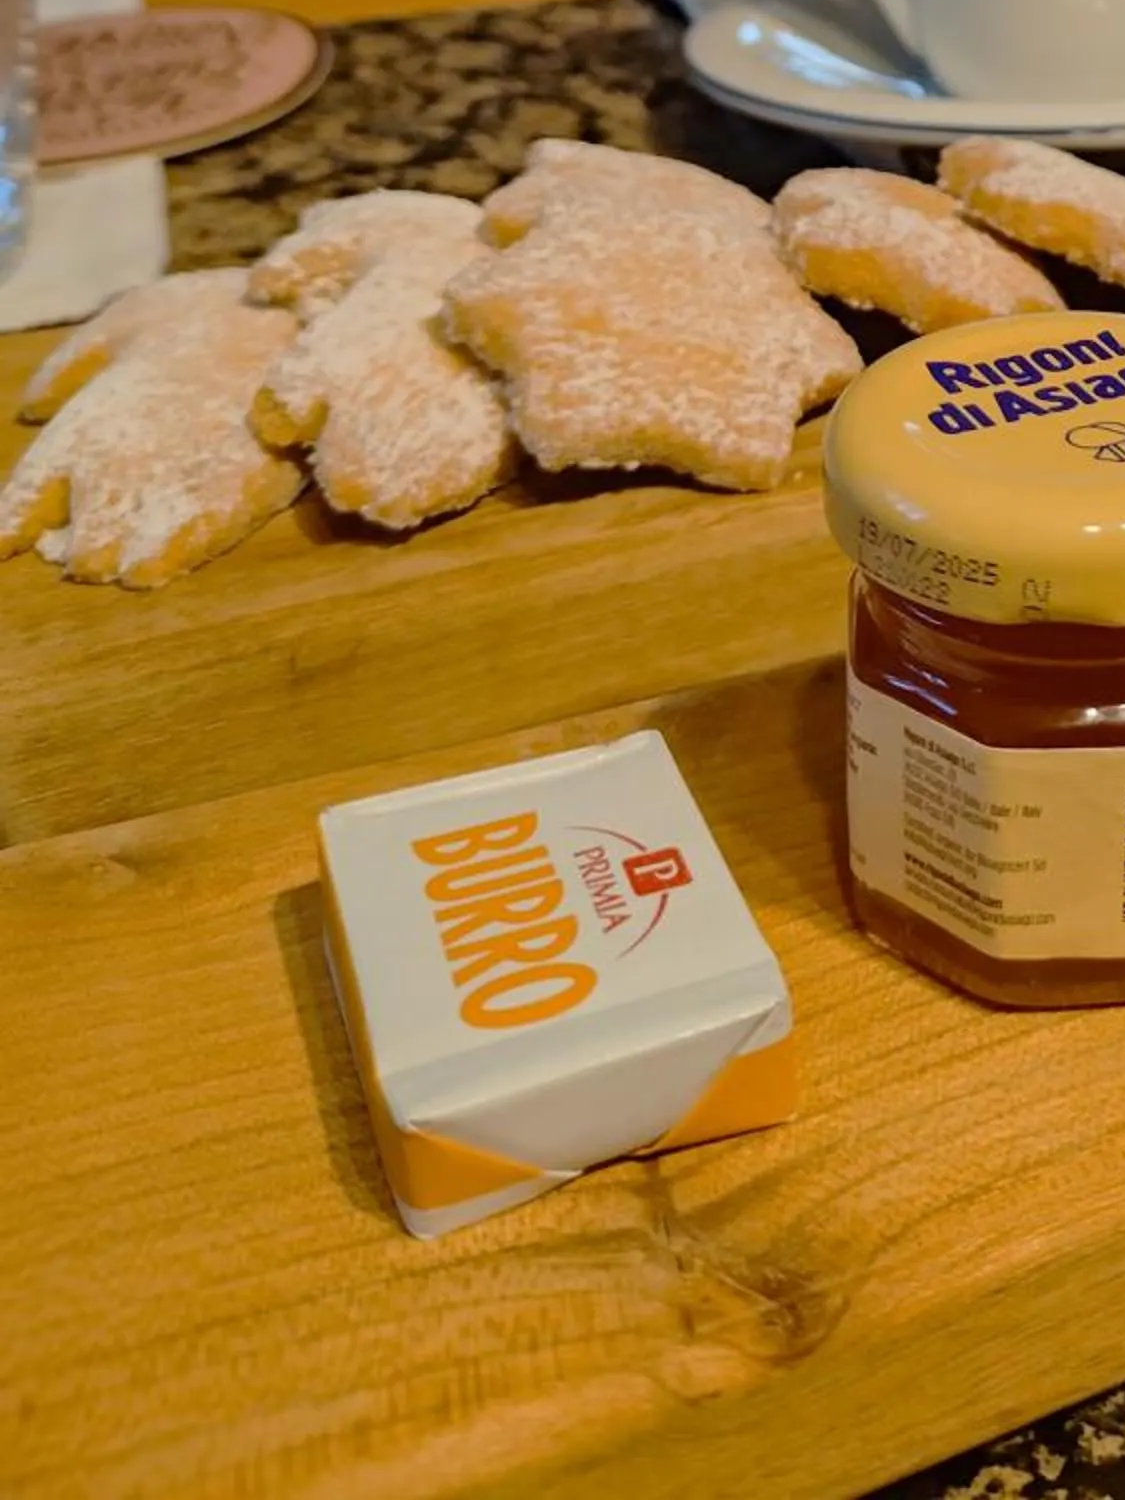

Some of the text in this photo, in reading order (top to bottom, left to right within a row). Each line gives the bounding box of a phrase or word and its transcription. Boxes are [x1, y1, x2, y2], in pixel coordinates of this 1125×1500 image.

[928, 403, 995, 434] di
[411, 811, 598, 1030] BURRO
[573, 845, 632, 934] PRIMIA
